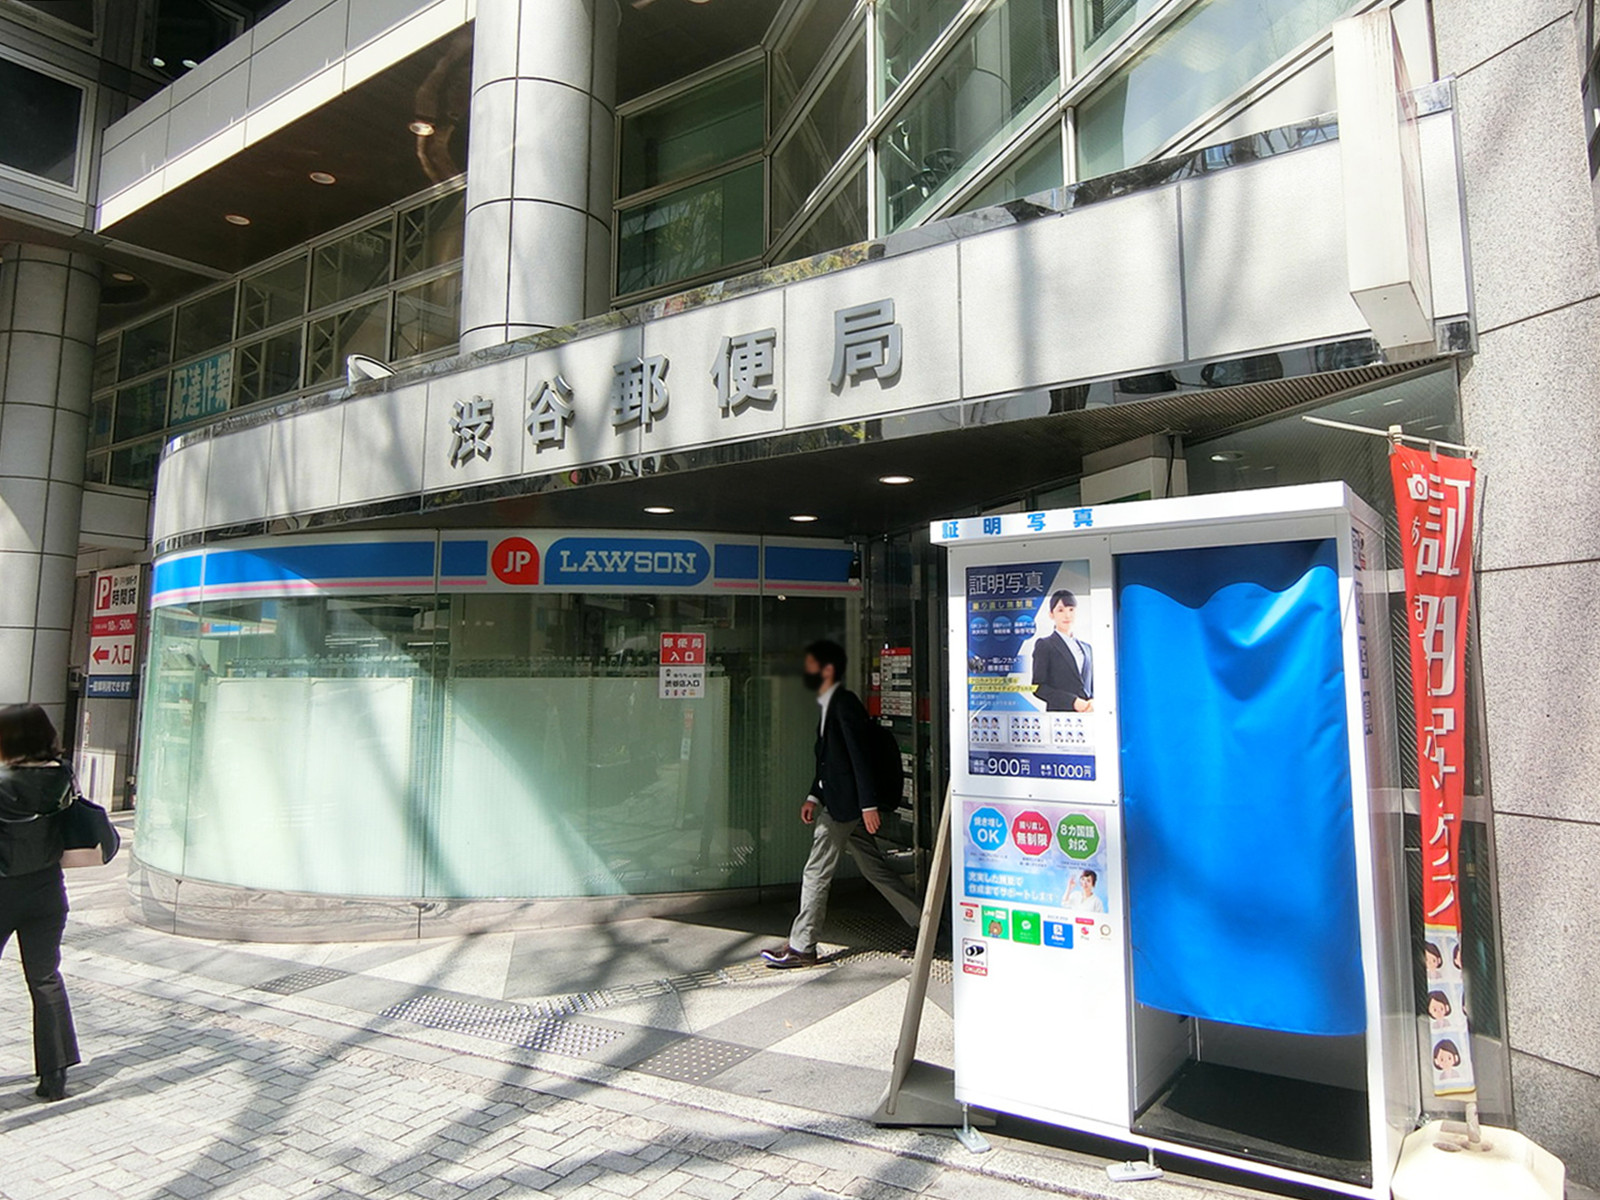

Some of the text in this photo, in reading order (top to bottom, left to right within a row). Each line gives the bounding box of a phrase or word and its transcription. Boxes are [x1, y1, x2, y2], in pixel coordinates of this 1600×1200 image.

[448, 298, 903, 467] 渋谷郵便局
[942, 508, 1093, 539] 証明写真
[503, 551, 531, 572] JP
[560, 550, 696, 573] LAWSON
[969, 571, 1044, 595] 証明写真
[663, 638, 702, 648] 郵便局
[111, 645, 132, 664] 入口
[670, 651, 694, 661] 入口
[988, 757, 1030, 775] 900円
[974, 817, 1003, 828] 焼き増し
[977, 829, 1000, 844] OK
[1016, 832, 1048, 846] 無制限
[1068, 838, 1088, 851] 対応
